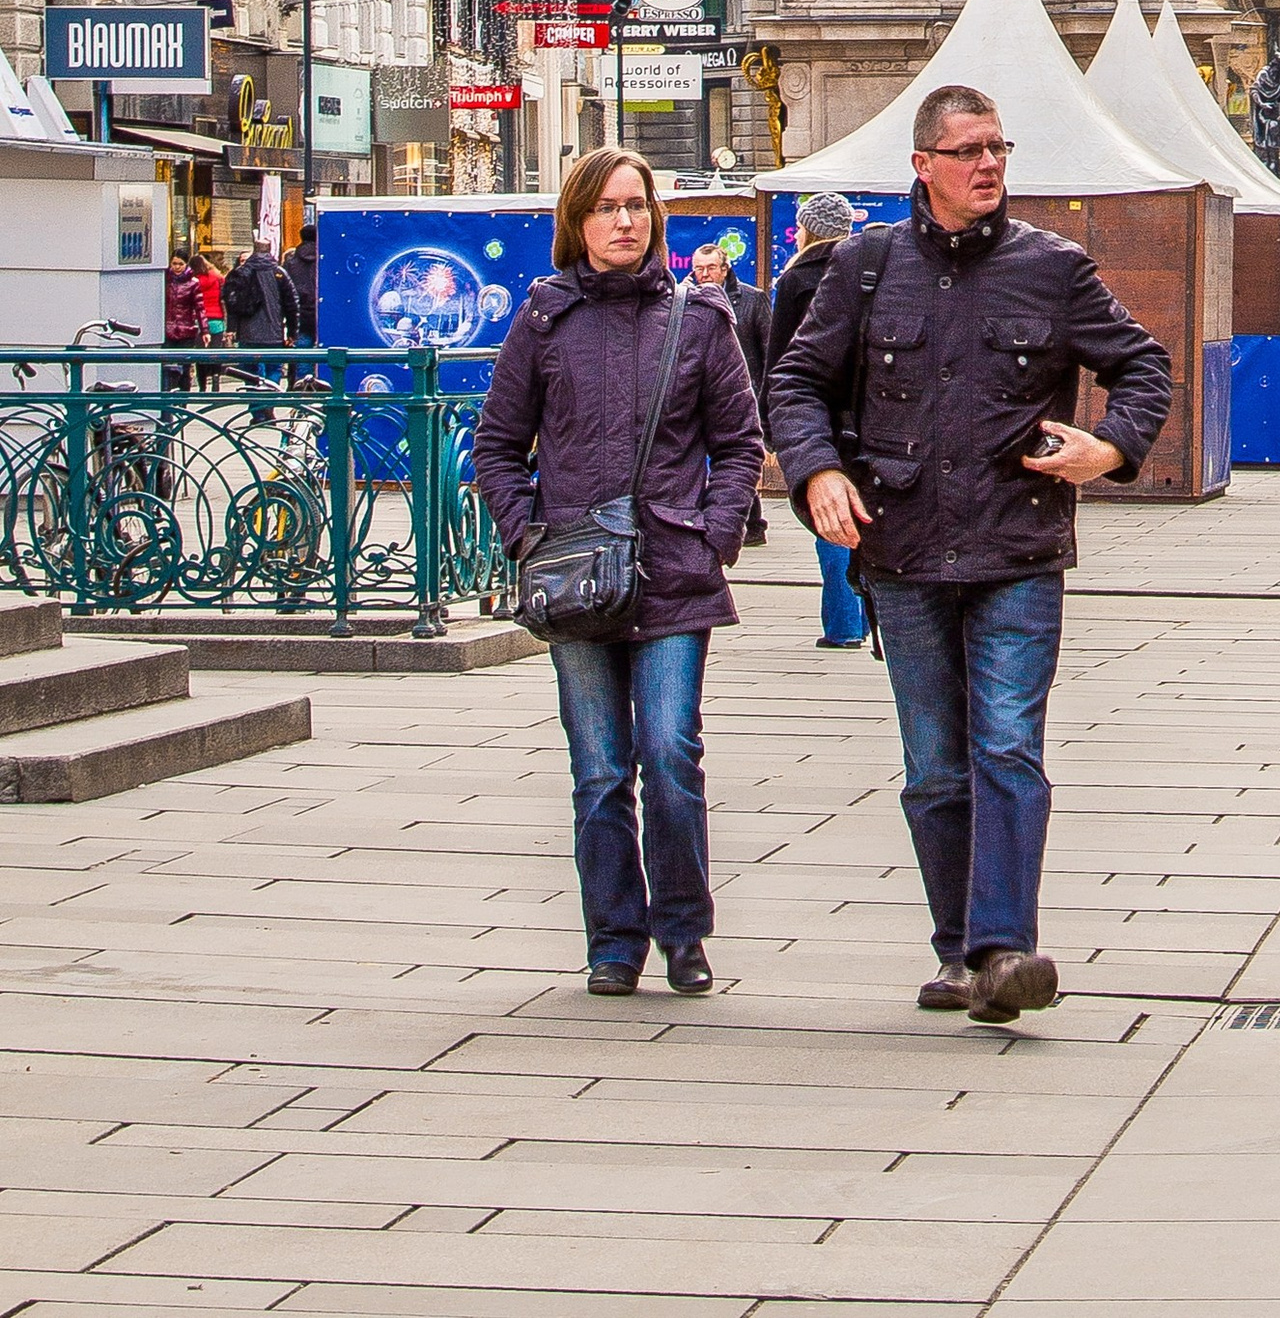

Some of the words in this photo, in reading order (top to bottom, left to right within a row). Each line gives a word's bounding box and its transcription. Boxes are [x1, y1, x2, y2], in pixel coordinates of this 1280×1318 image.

[643, 9, 700, 19] ESPRESSO
[547, 26, 595, 44] CAMPER
[663, 24, 716, 37] WEBER
[666, 64, 681, 76] of
[451, 89, 501, 105] Triumph
